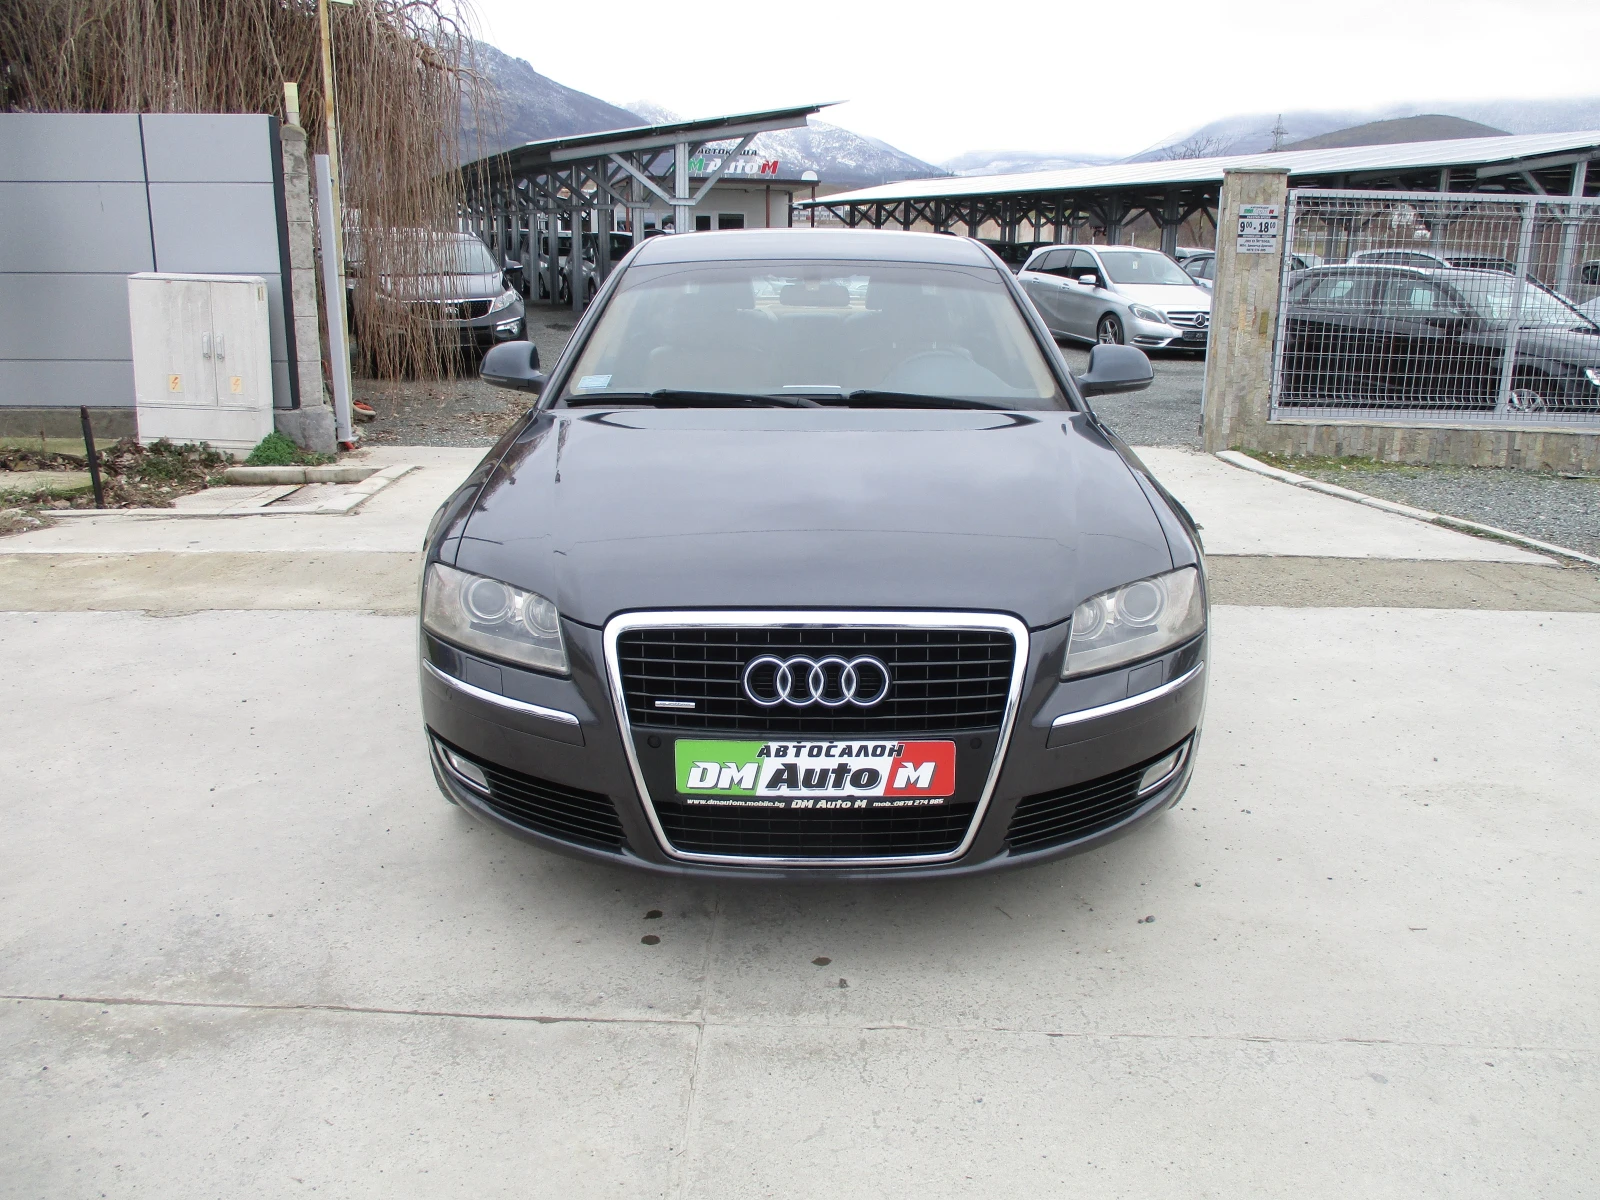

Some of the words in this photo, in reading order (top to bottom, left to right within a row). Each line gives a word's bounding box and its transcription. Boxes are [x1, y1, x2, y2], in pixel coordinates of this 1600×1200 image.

[761, 160, 778, 175] M
[757, 744, 904, 758] АВТОСАЛОН
[686, 761, 760, 790] DM
[765, 762, 881, 790] Auto
[893, 761, 937, 789] M
[687, 798, 785, 808] www.dmautom.mobile.bg
[791, 799, 814, 808] DM
[816, 799, 850, 809] Auto
[854, 800, 868, 808] M
